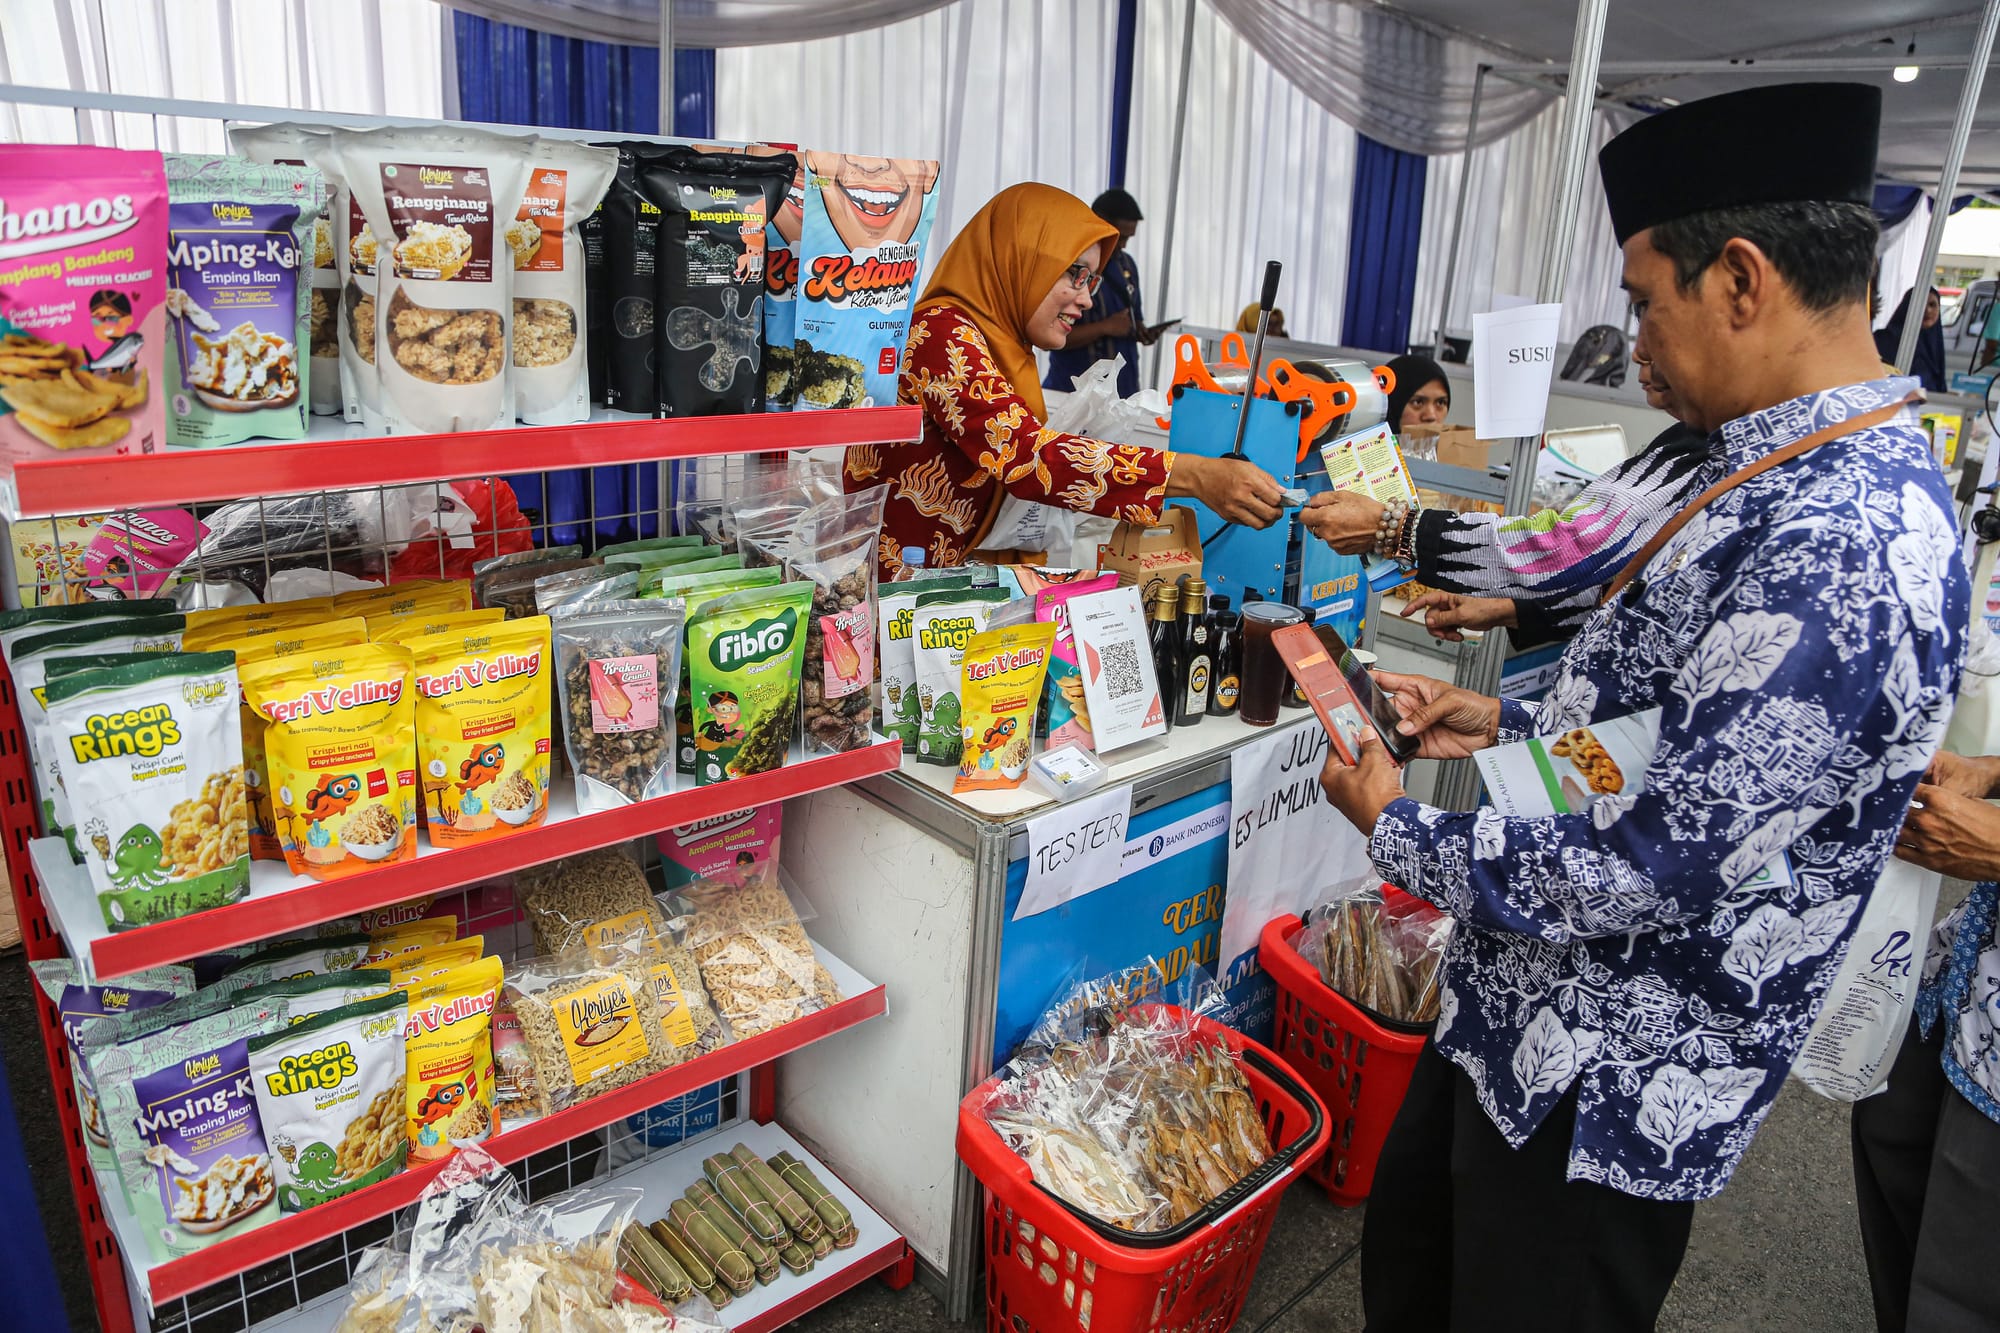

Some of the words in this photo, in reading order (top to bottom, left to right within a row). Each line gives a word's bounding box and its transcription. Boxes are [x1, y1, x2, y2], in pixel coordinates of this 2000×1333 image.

[393, 195, 488, 212] Rengginang
[690, 210, 764, 224] Rengginang
[64, 246, 134, 272] Bandeng
[202, 271, 250, 285] Emping
[253, 271, 281, 283] Ikan
[851, 292, 884, 307] Ketan
[1508, 346, 1553, 364] SUSU
[1311, 573, 1359, 601] KERIYES
[835, 612, 865, 631] Kraken
[929, 617, 974, 630] Ocean
[719, 623, 788, 664] Fibro
[920, 628, 976, 650] Rings
[603, 662, 643, 675] Kraken
[622, 670, 651, 682] Crunch
[87, 703, 171, 734] Ocean
[466, 719, 486, 728] Krispi
[487, 715, 500, 724] teri
[501, 713, 513, 721] nasi
[482, 725, 494, 734] fried
[71, 719, 181, 764] Rings
[313, 747, 336, 757] Krispi
[337, 744, 352, 754] teri
[353, 742, 370, 752] nasi
[131, 757, 160, 771] Krispi
[161, 752, 184, 764] Cumi
[311, 756, 330, 766] Crispy
[331, 754, 345, 763] fried
[132, 769, 158, 781] Squid
[1487, 757, 1517, 815] SEKARBUMI
[1166, 831, 1186, 847] BANK
[1187, 814, 1225, 838] INDONESIA
[1235, 810, 1253, 849] ES
[689, 838, 724, 856] Amplang
[724, 827, 756, 843] Bandeng
[1036, 813, 1122, 875] TESTER
[1162, 884, 1226, 934] GER
[570, 988, 628, 1035] Keriyes
[280, 1041, 351, 1072] Ocean
[423, 1060, 443, 1070] Krispi
[445, 1056, 458, 1065] teri
[266, 1055, 358, 1096] Rings
[314, 1088, 340, 1102] Krispi
[340, 1082, 359, 1094] Cumi
[180, 1114, 226, 1137] Emping
[228, 1103, 252, 1119] Ikan
[637, 1115, 679, 1127] PASAR
